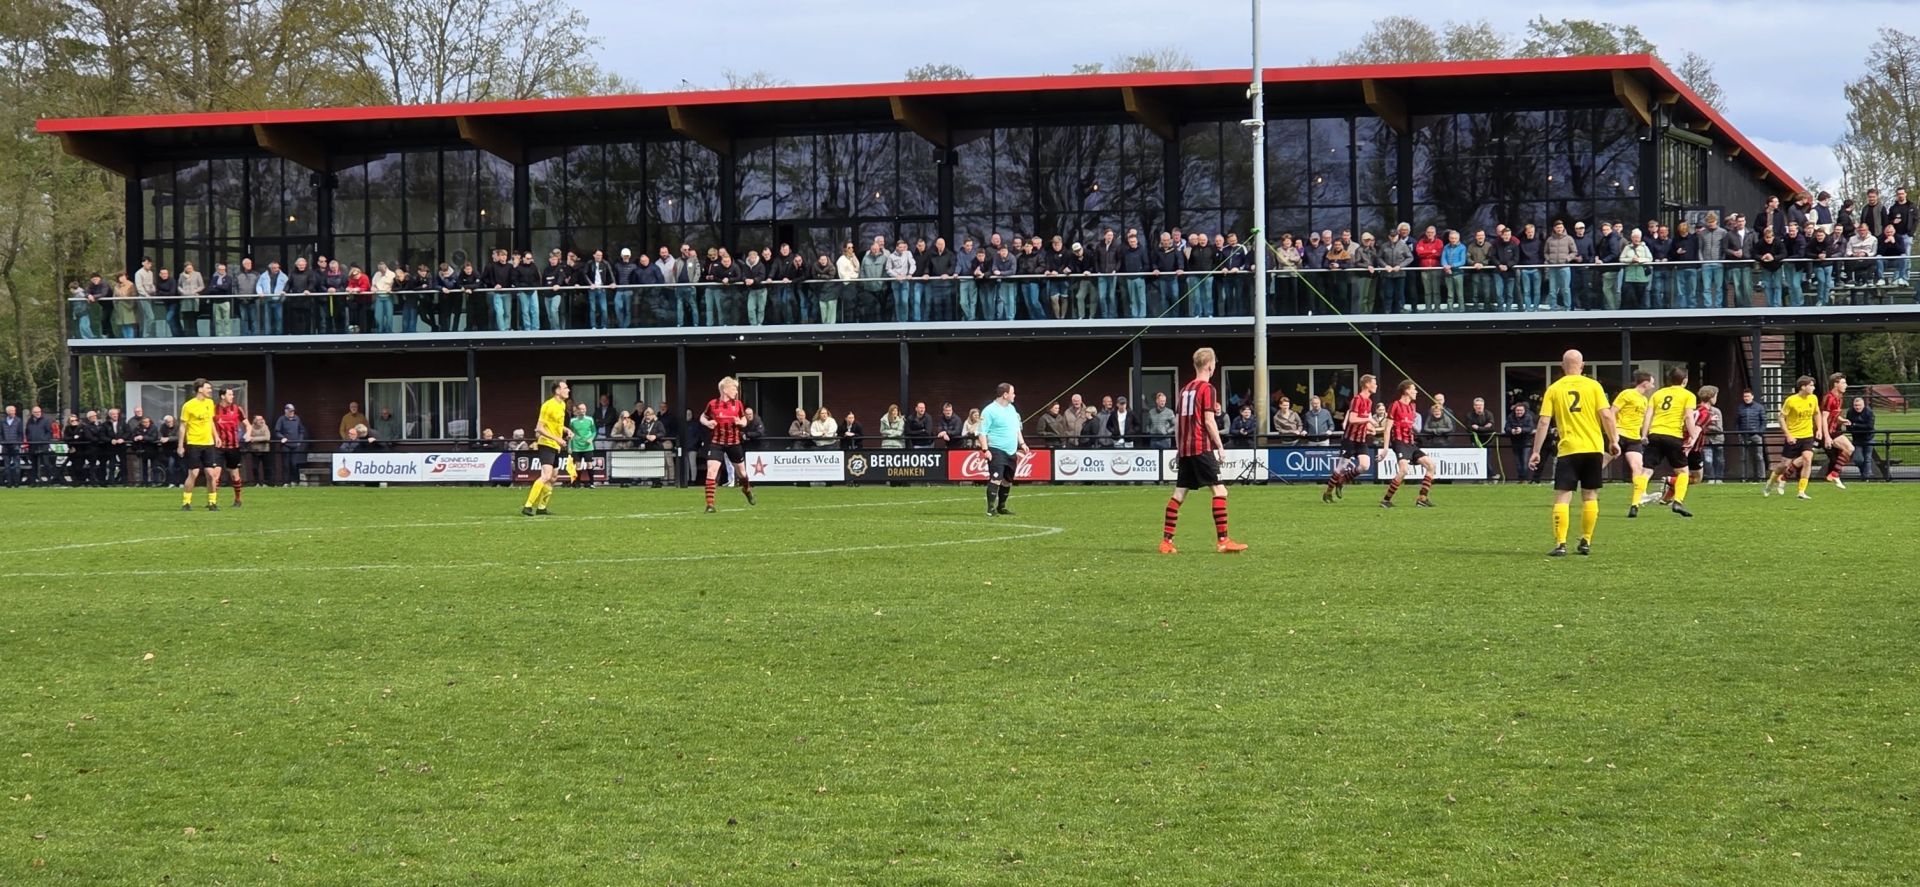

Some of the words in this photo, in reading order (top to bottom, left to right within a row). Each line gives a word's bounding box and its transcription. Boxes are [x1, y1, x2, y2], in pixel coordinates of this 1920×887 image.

[1181, 390, 1197, 416] 11
[1567, 390, 1582, 412] 2
[1661, 395, 1673, 411] 8
[773, 455, 812, 465] Kruders
[814, 454, 840, 464] Weda
[870, 454, 942, 468] BERGHORST
[354, 461, 417, 475] Rabobank
[887, 467, 925, 477] DRANKEN
[1440, 460, 1480, 476] DELDEN
